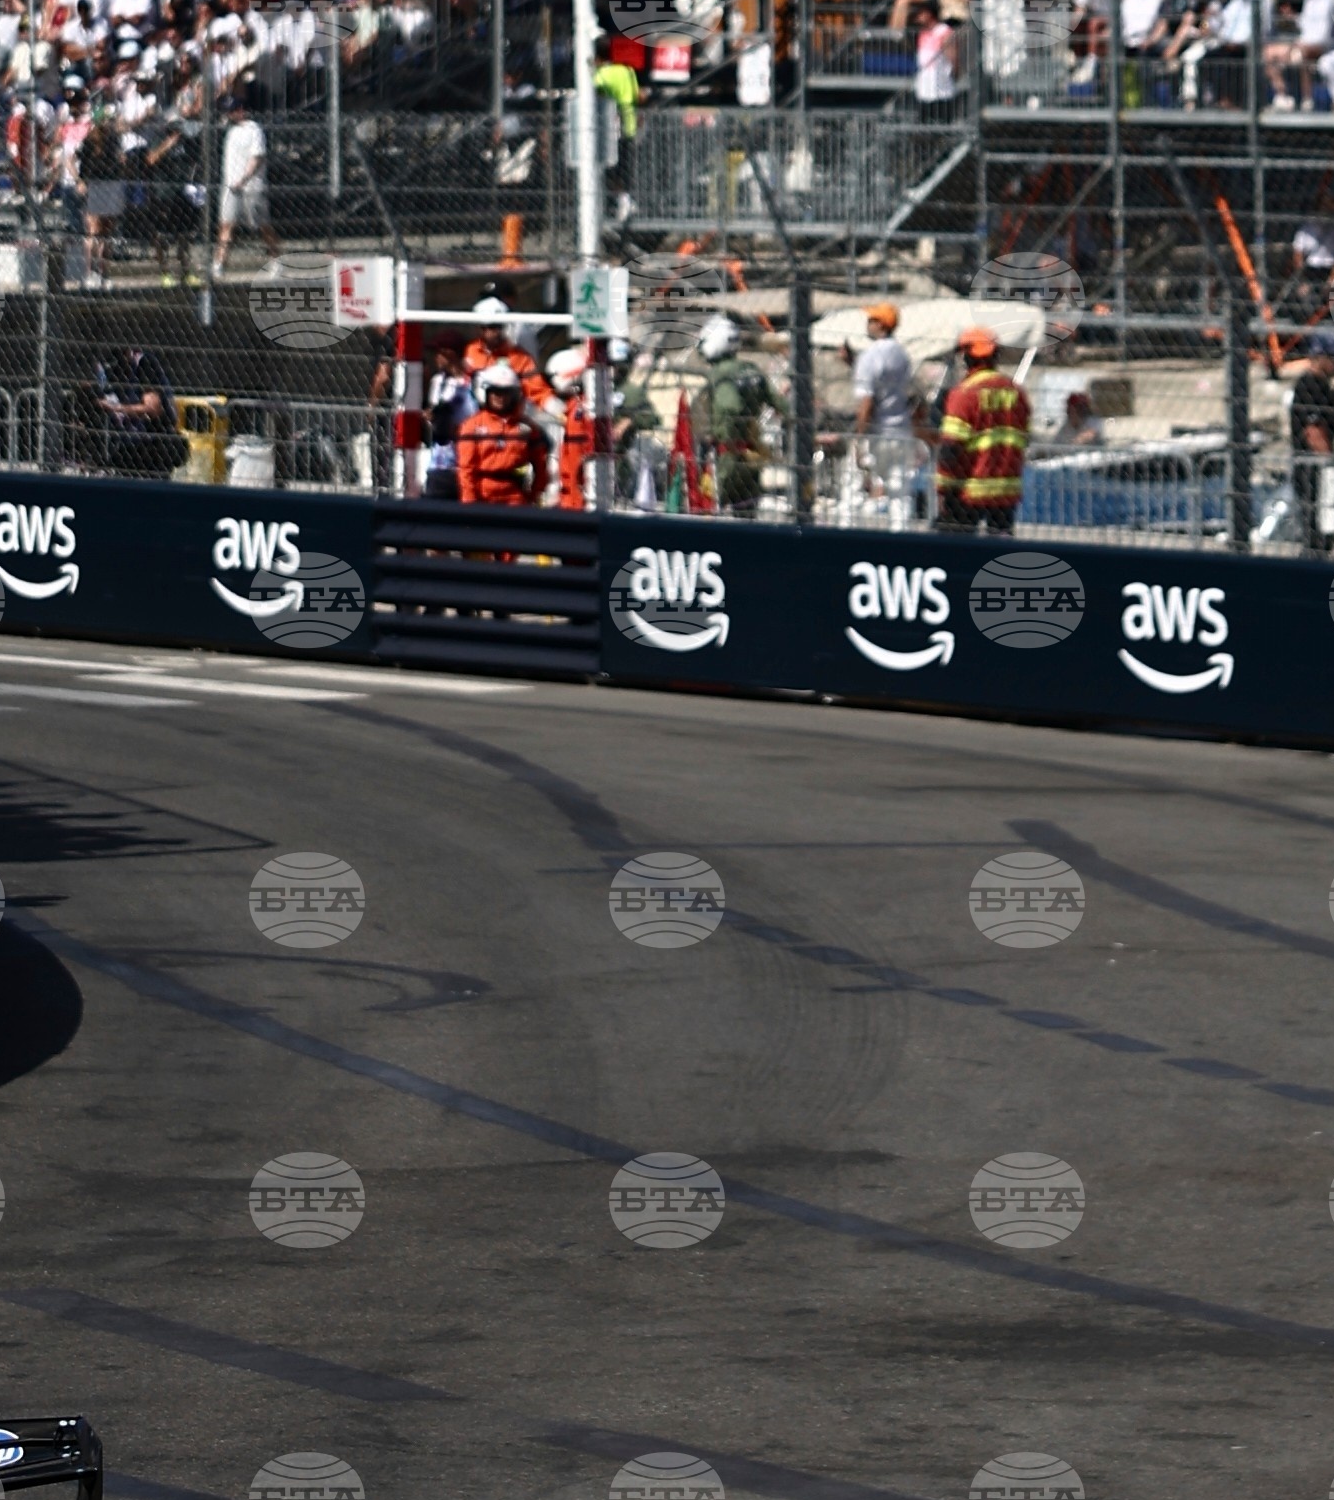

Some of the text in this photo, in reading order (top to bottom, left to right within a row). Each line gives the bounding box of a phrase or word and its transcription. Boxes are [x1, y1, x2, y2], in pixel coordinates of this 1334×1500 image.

[213, 517, 301, 576] aws
[629, 547, 726, 608] aws
[849, 562, 950, 626] aws
[1122, 582, 1229, 647] aws
